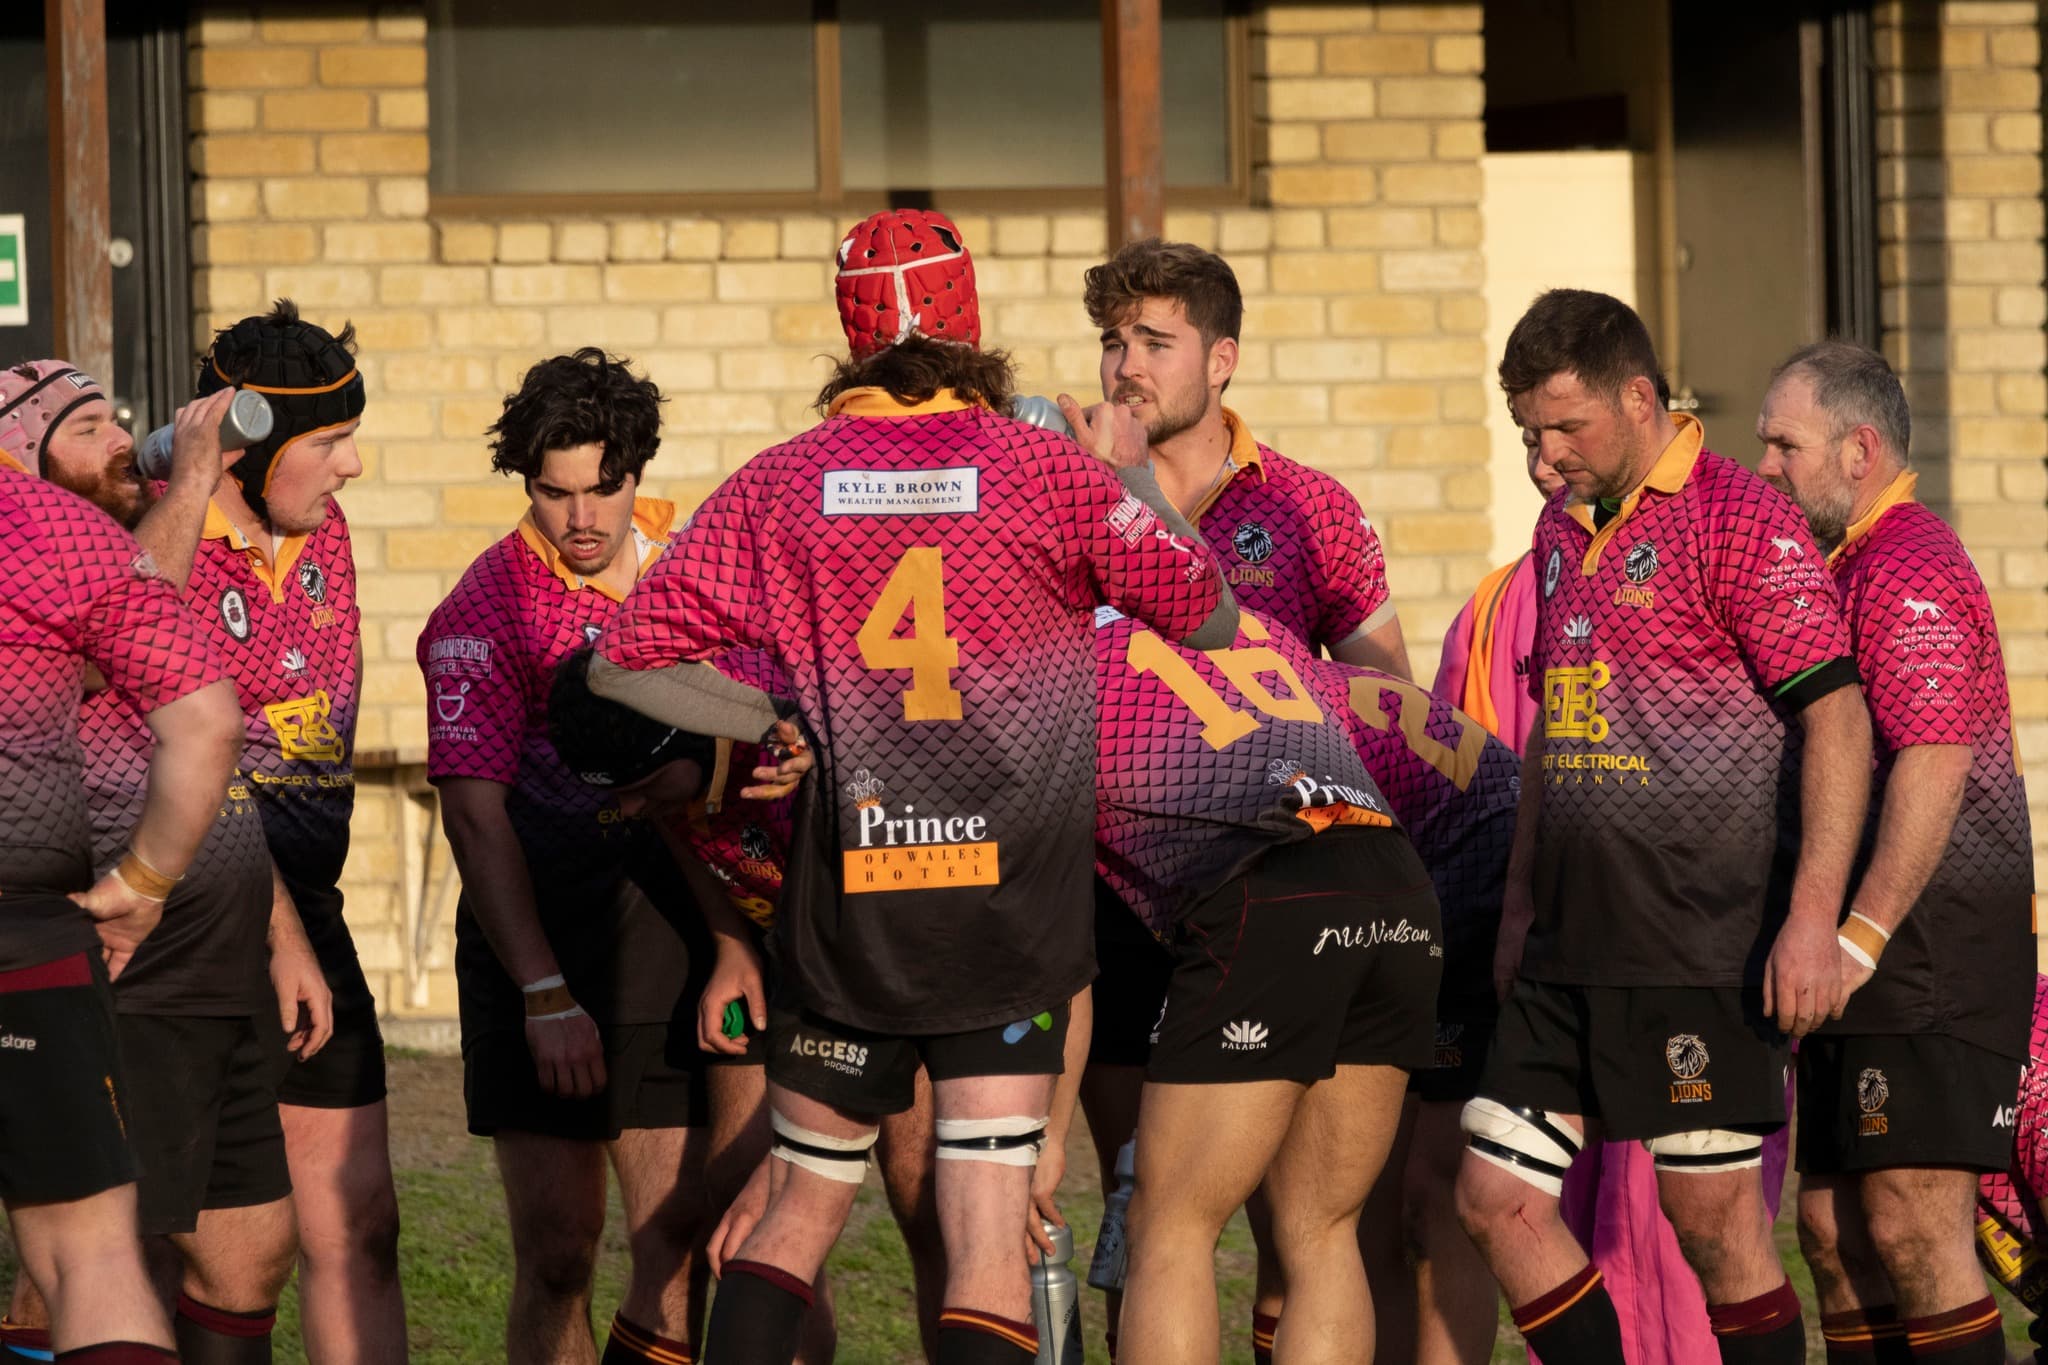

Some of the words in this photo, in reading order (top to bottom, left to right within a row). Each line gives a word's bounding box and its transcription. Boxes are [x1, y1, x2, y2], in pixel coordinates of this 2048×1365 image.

[838, 482, 887, 493] KYLE
[895, 480, 962, 493] BROWN
[838, 497, 882, 505] WEALTH
[886, 496, 962, 505] MANAGEMENT
[1230, 567, 1274, 588] LIONS
[1613, 588, 1654, 609] LIONS
[856, 547, 963, 721] 4
[1892, 634, 1964, 645] INDEPENDENT
[1898, 625, 1957, 635] TASMANIAN
[1903, 643, 1956, 653] BOTTLERS
[1127, 610, 1324, 751] 16
[450, 732, 477, 741] PRESS
[1348, 676, 1488, 793] 2
[1558, 754, 1651, 771] ELECTRICAL
[1294, 775, 1382, 812] Prince
[858, 805, 987, 847] Prince
[864, 852, 890, 866] OF
[907, 847, 982, 863] WALES
[739, 861, 783, 881] LIONS
[865, 864, 983, 883] HOTEL
[1362, 918, 1432, 949] Nelson
[0, 1033, 37, 1051] store
[790, 1033, 868, 1067] ACCESS
[1222, 1041, 1267, 1051] PALADIN
[824, 1060, 863, 1078] PROPERTY
[1670, 1083, 1712, 1103] LIONS
